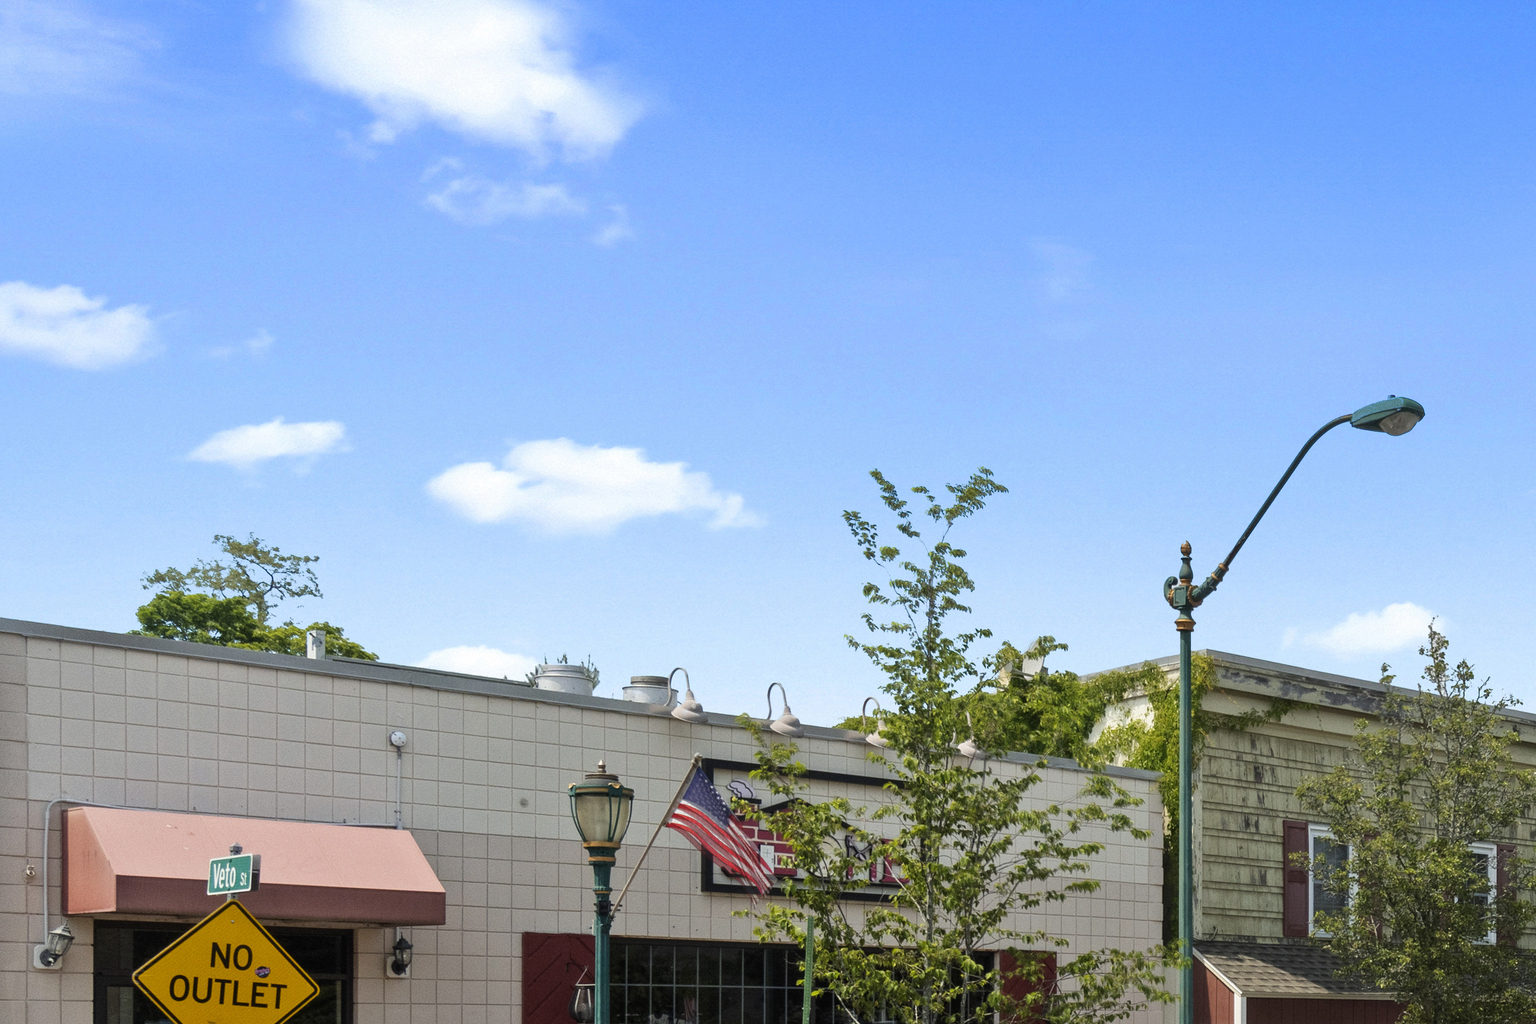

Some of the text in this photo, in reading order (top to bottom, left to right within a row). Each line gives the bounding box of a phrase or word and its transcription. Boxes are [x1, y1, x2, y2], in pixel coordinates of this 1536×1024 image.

[213, 863, 247, 889] Veto St
[210, 942, 253, 971] NO
[169, 974, 287, 1010] OUTLET
